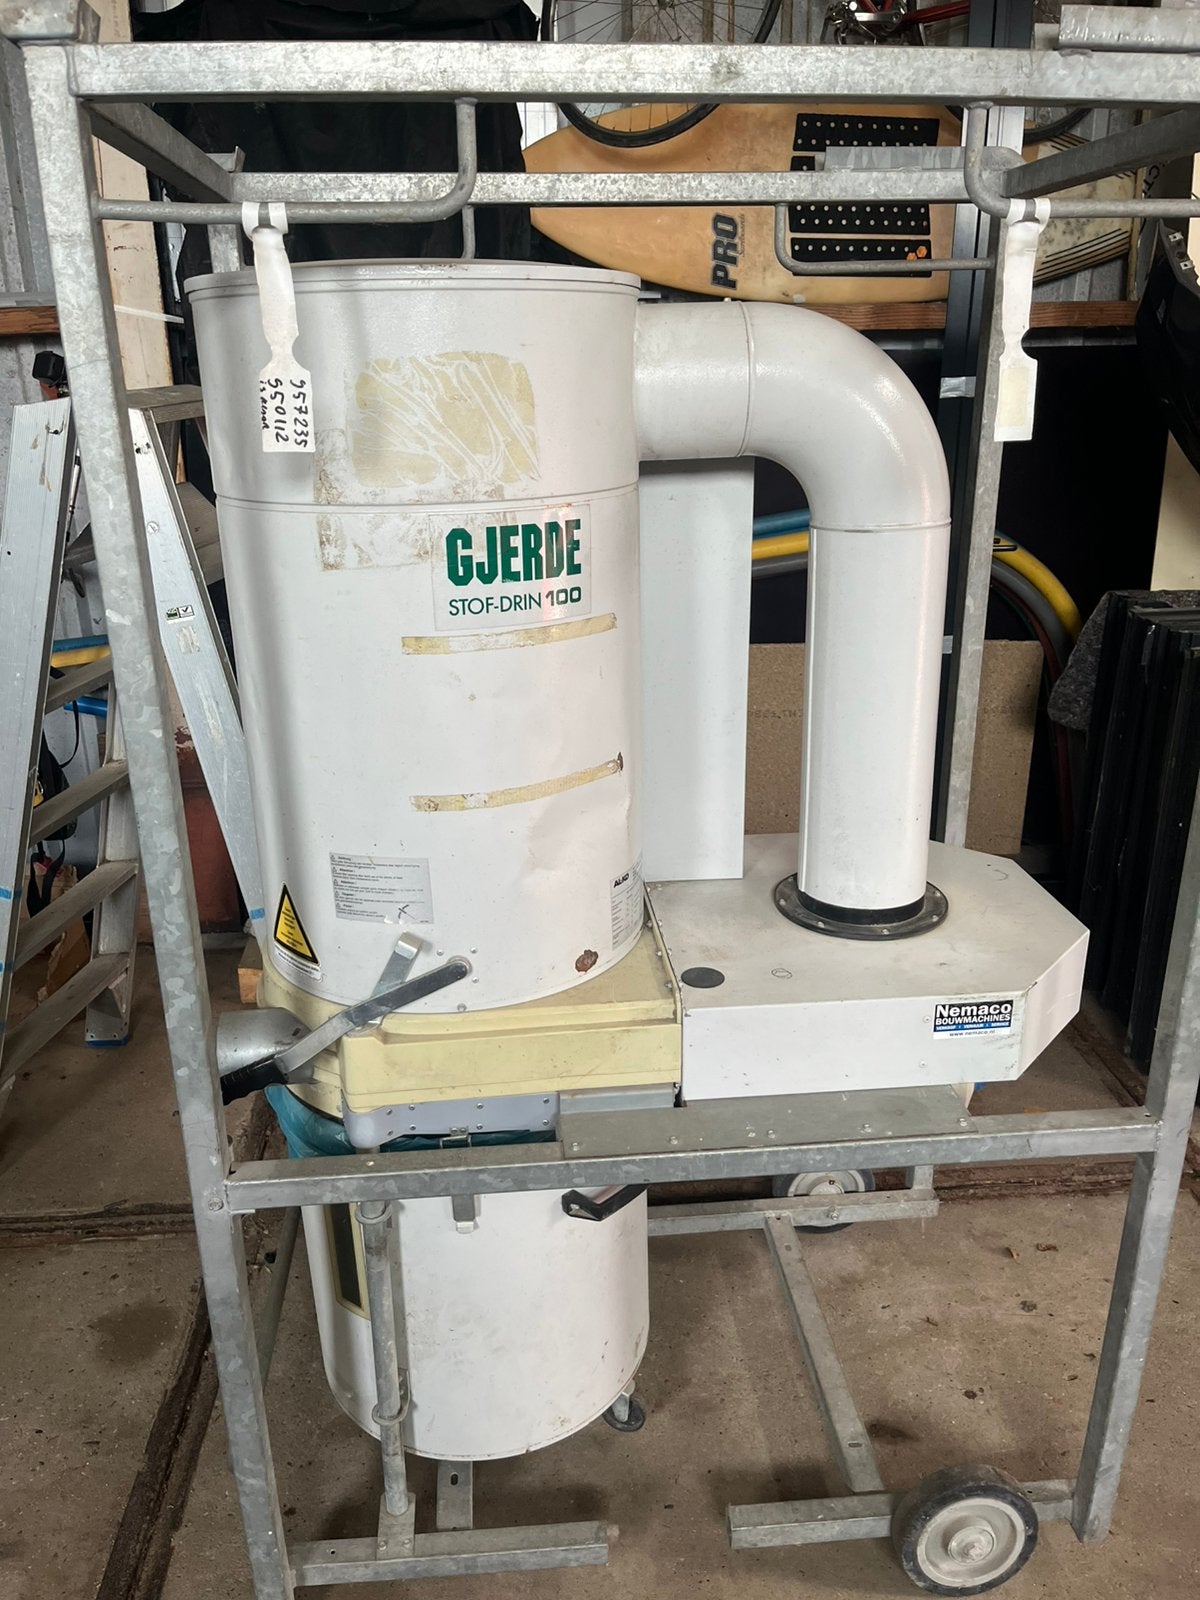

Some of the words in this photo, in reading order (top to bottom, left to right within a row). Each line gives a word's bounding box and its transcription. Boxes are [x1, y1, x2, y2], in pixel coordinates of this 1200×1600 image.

[711, 212, 738, 290] PRO
[445, 519, 582, 586] GJERDE
[448, 592, 542, 616] STOF-DRIN
[545, 586, 582, 607] 100
[935, 1014, 1011, 1025] BOUWMACHINES
[936, 1003, 1012, 1018] Nemaco
